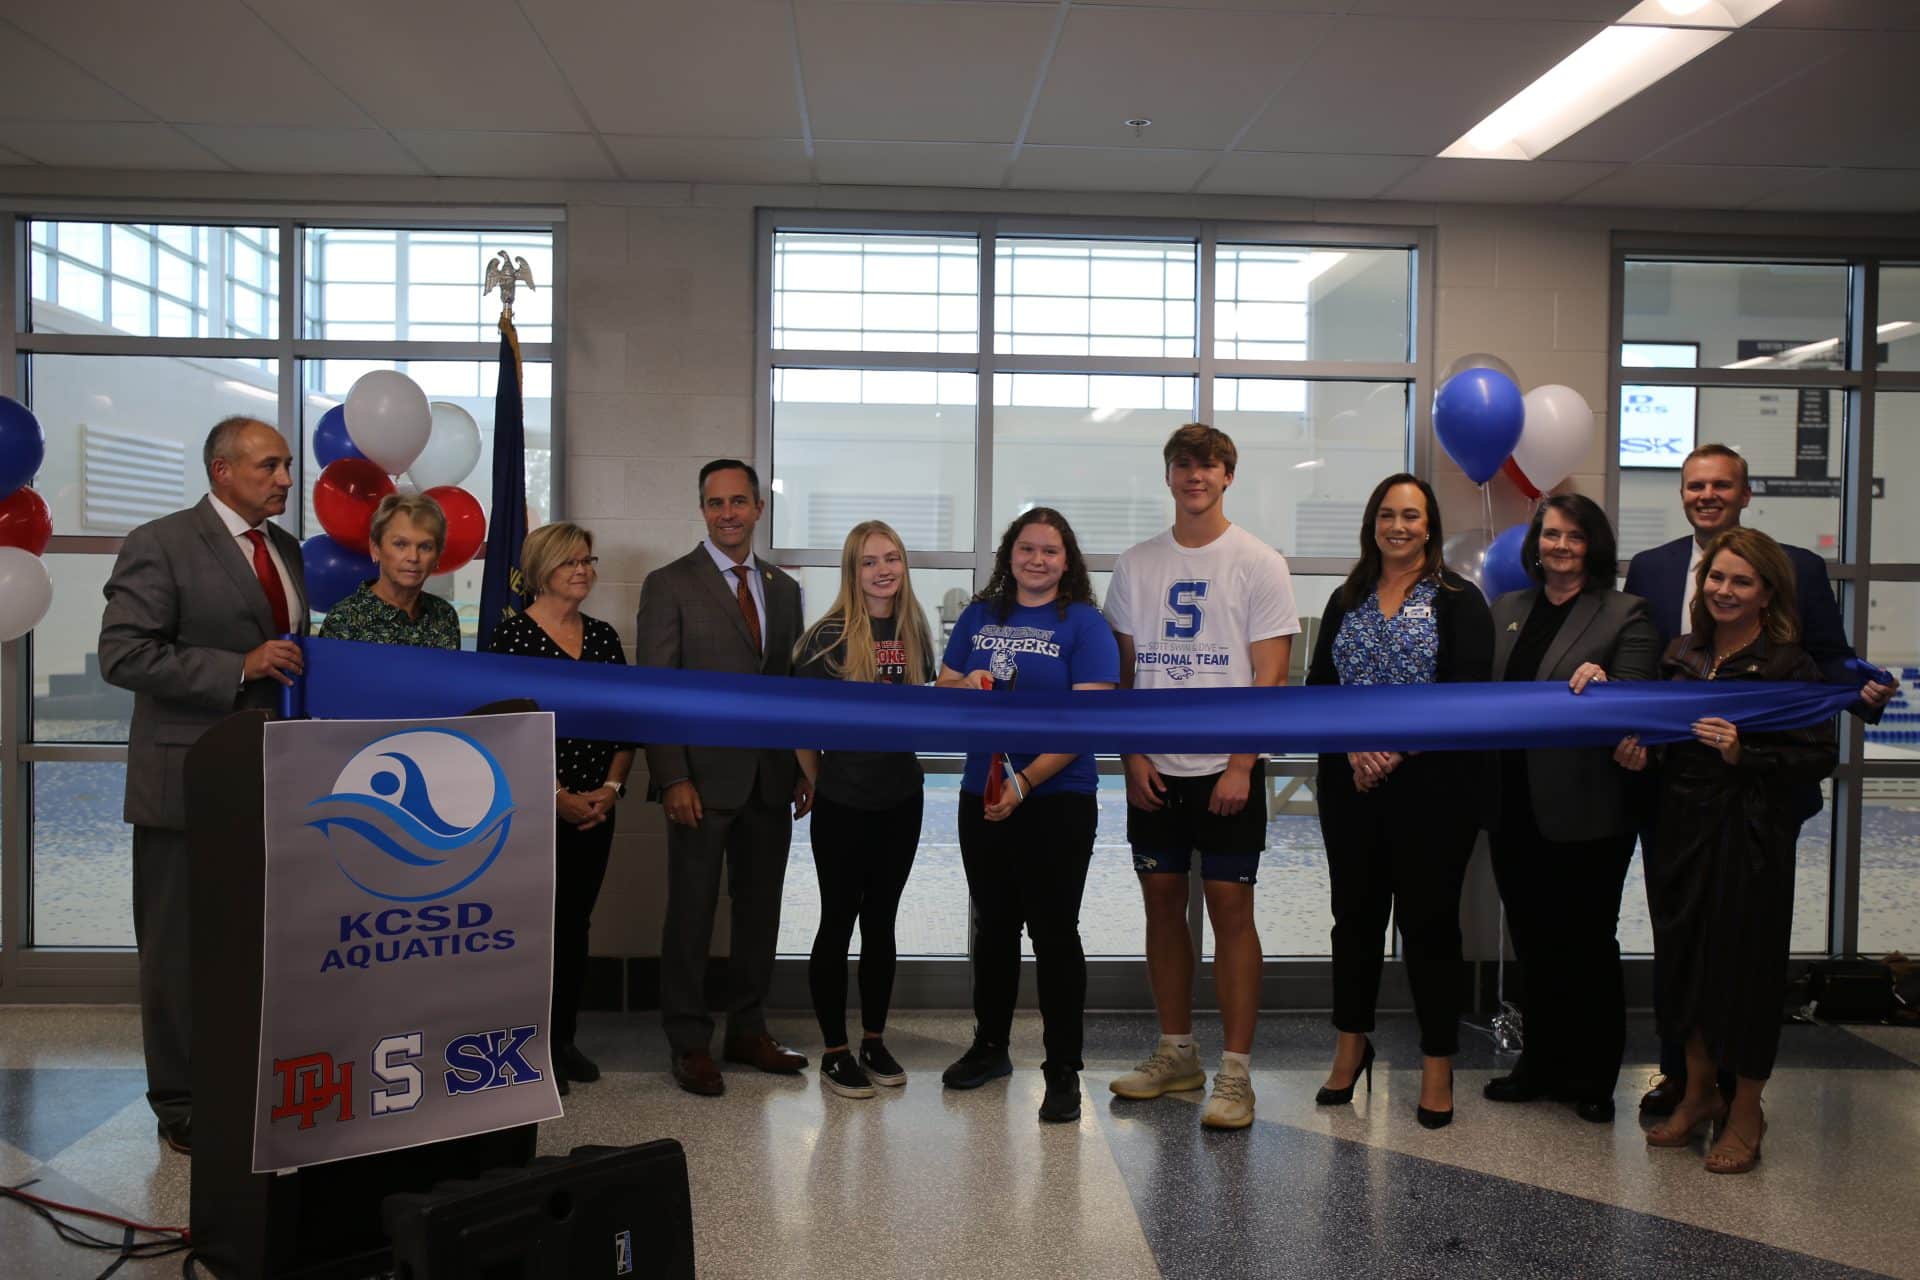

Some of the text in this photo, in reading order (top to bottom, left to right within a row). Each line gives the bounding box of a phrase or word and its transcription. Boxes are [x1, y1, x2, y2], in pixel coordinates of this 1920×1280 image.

[1161, 579, 1209, 642] S
[1196, 653, 1230, 666] TEAM
[339, 902, 494, 943] KCSD
[320, 929, 516, 973] AQUATICS
[370, 1031, 424, 1117] S
[443, 1024, 543, 1096] SK
